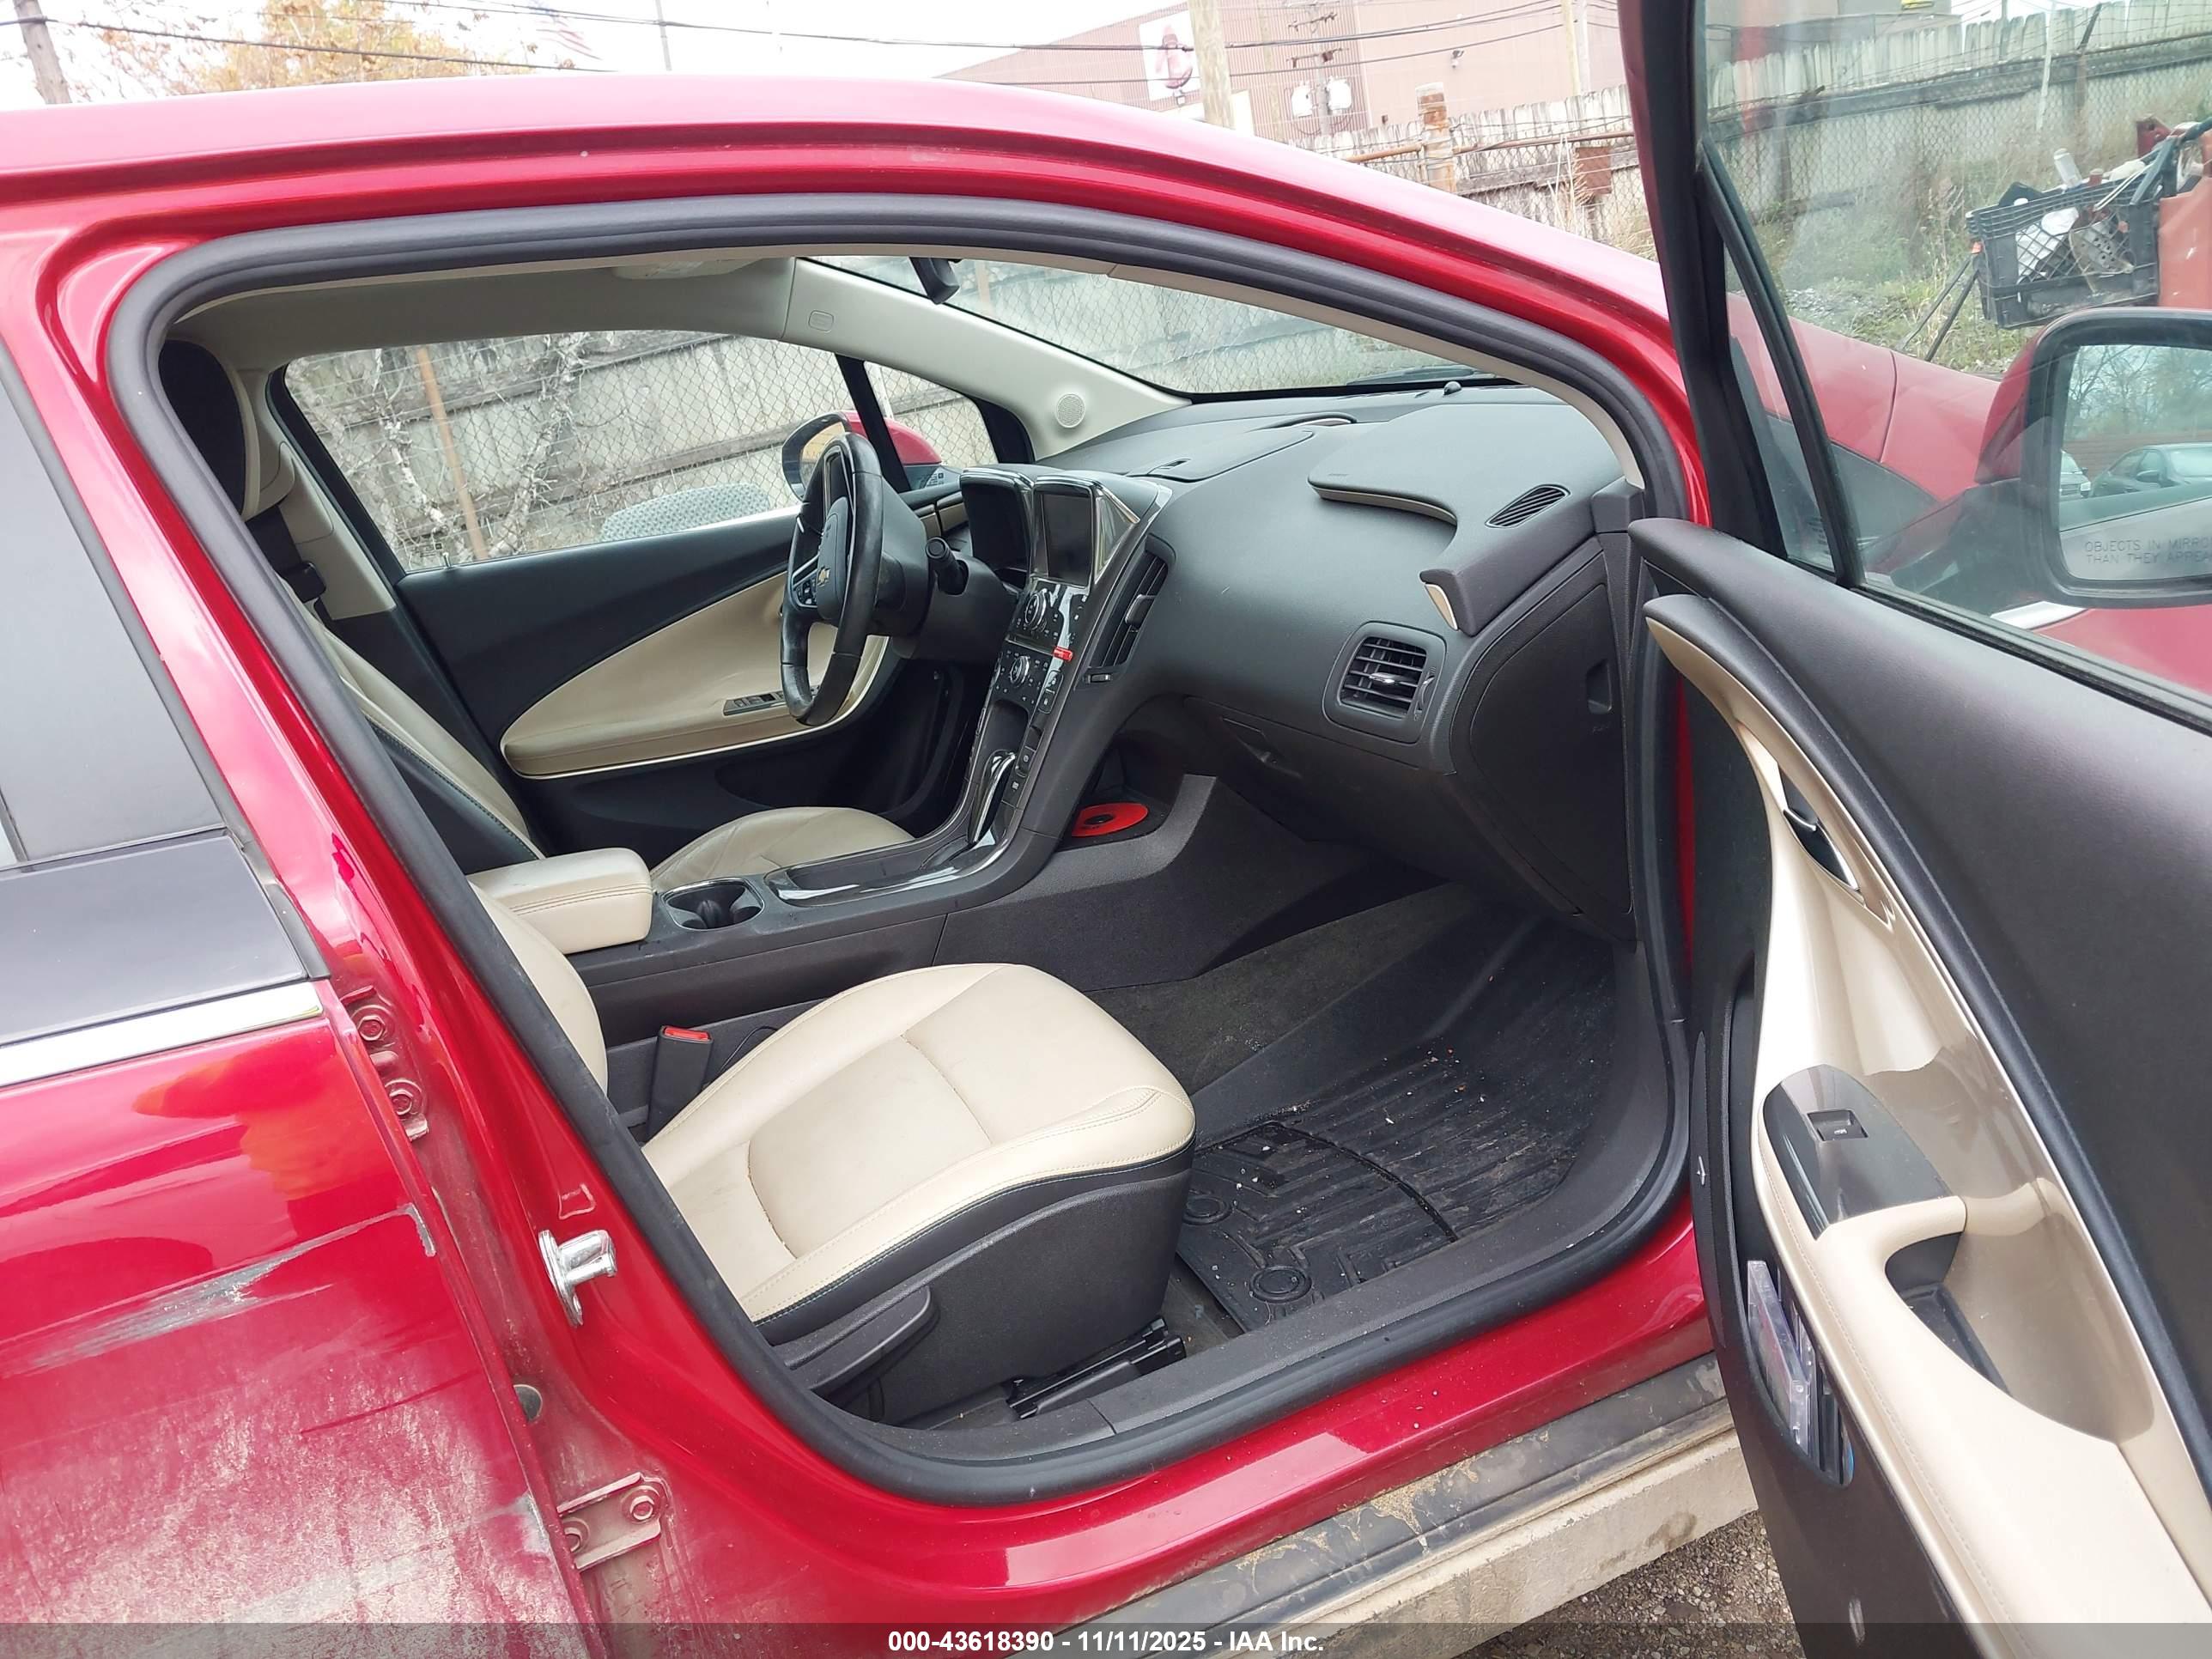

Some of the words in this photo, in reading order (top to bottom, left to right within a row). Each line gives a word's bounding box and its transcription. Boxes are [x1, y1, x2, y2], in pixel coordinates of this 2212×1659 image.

[2084, 539, 2141, 551] OBJECTS
[2148, 539, 2160, 550] IN
[2169, 537, 2212, 550] MIRRO
[2086, 554, 2119, 564] THAN
[2127, 552, 2159, 564] THEY
